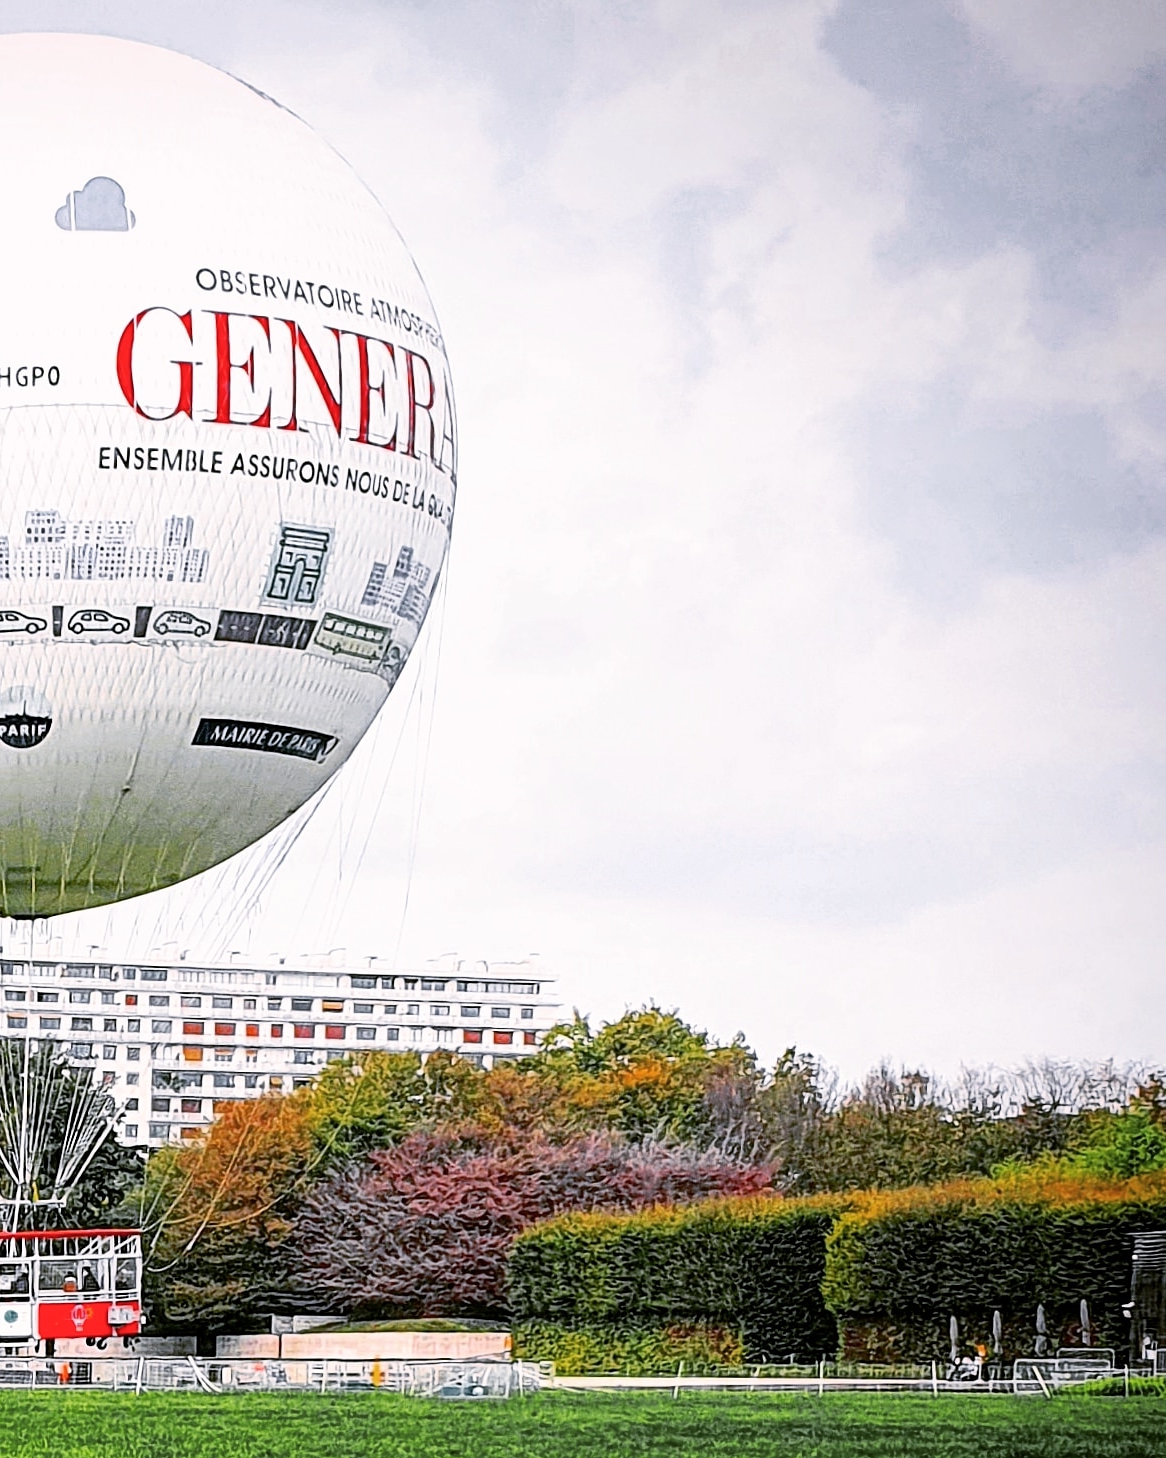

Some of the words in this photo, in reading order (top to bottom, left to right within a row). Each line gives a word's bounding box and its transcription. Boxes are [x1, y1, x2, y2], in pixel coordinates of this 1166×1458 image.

[195, 267, 365, 316] OBSERVATOIRE
[98, 446, 224, 474] ENSEMBLE
[230, 452, 340, 488] ASSURONS
[345, 467, 390, 499] NOUS
[392, 479, 411, 505] DE
[209, 725, 270, 746] MAIRIE
[267, 730, 292, 748] DE
